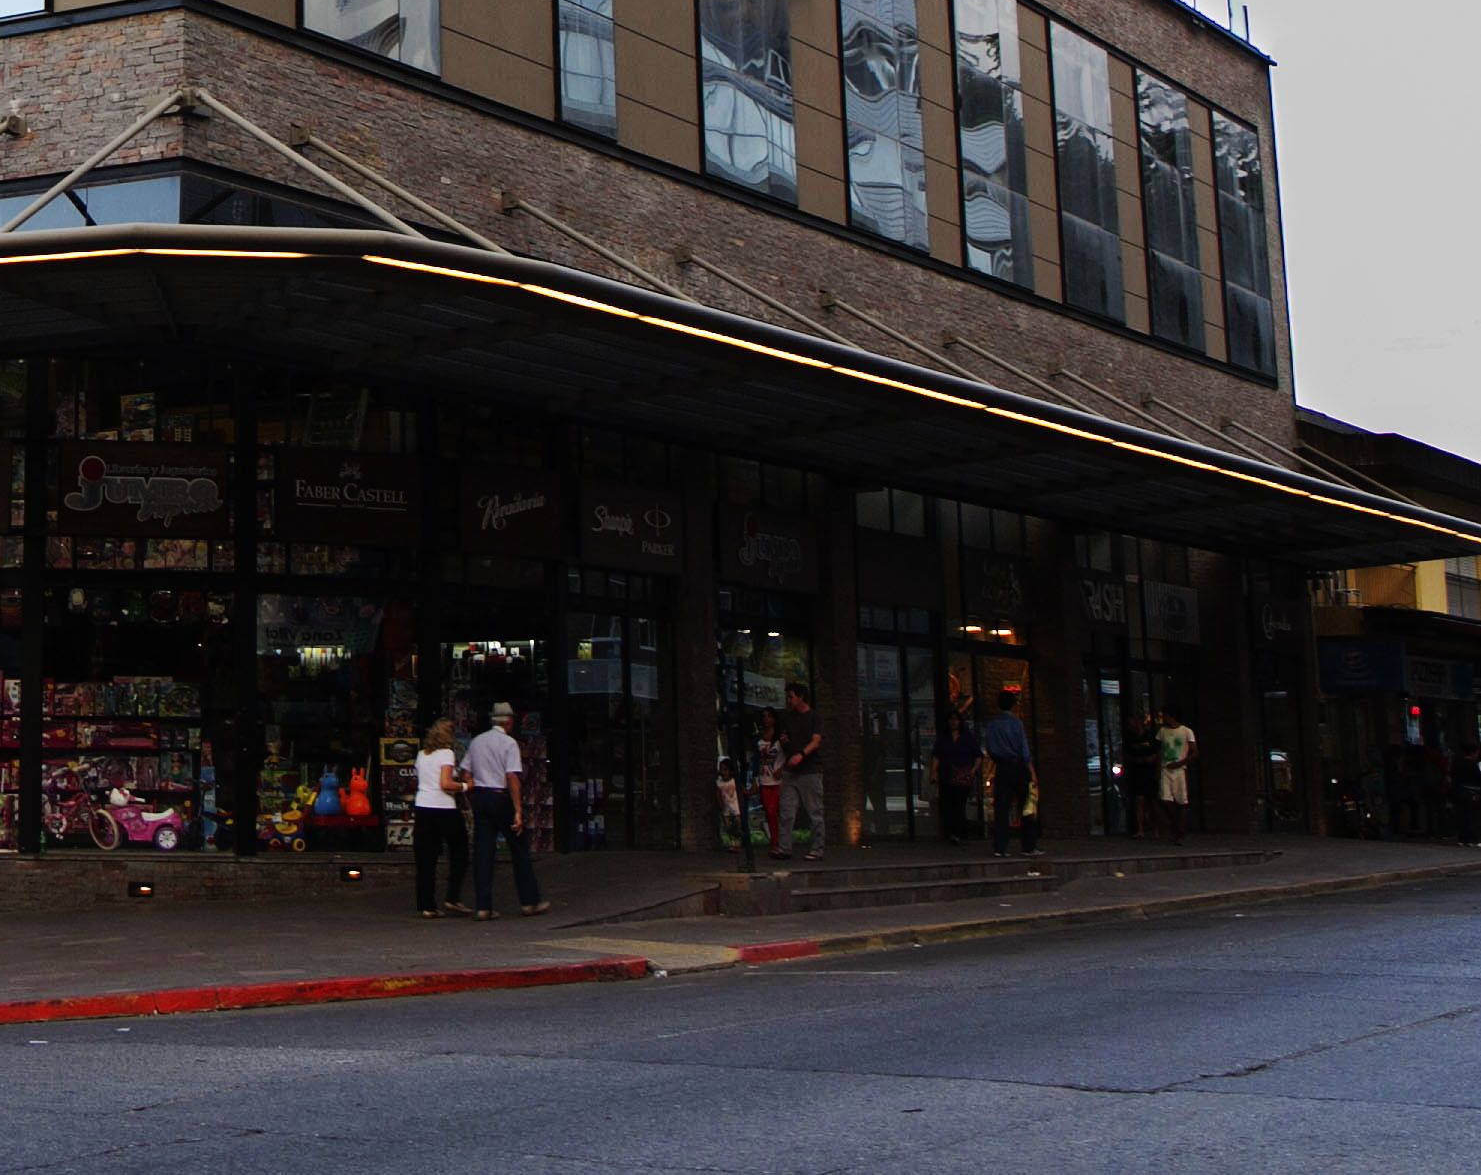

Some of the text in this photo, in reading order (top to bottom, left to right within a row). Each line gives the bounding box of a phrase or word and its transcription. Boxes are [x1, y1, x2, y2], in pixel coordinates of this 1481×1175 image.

[64, 475, 219, 512] JUMBO
[295, 479, 409, 505] FABER CASTELL
[641, 540, 676, 557] PARKER
